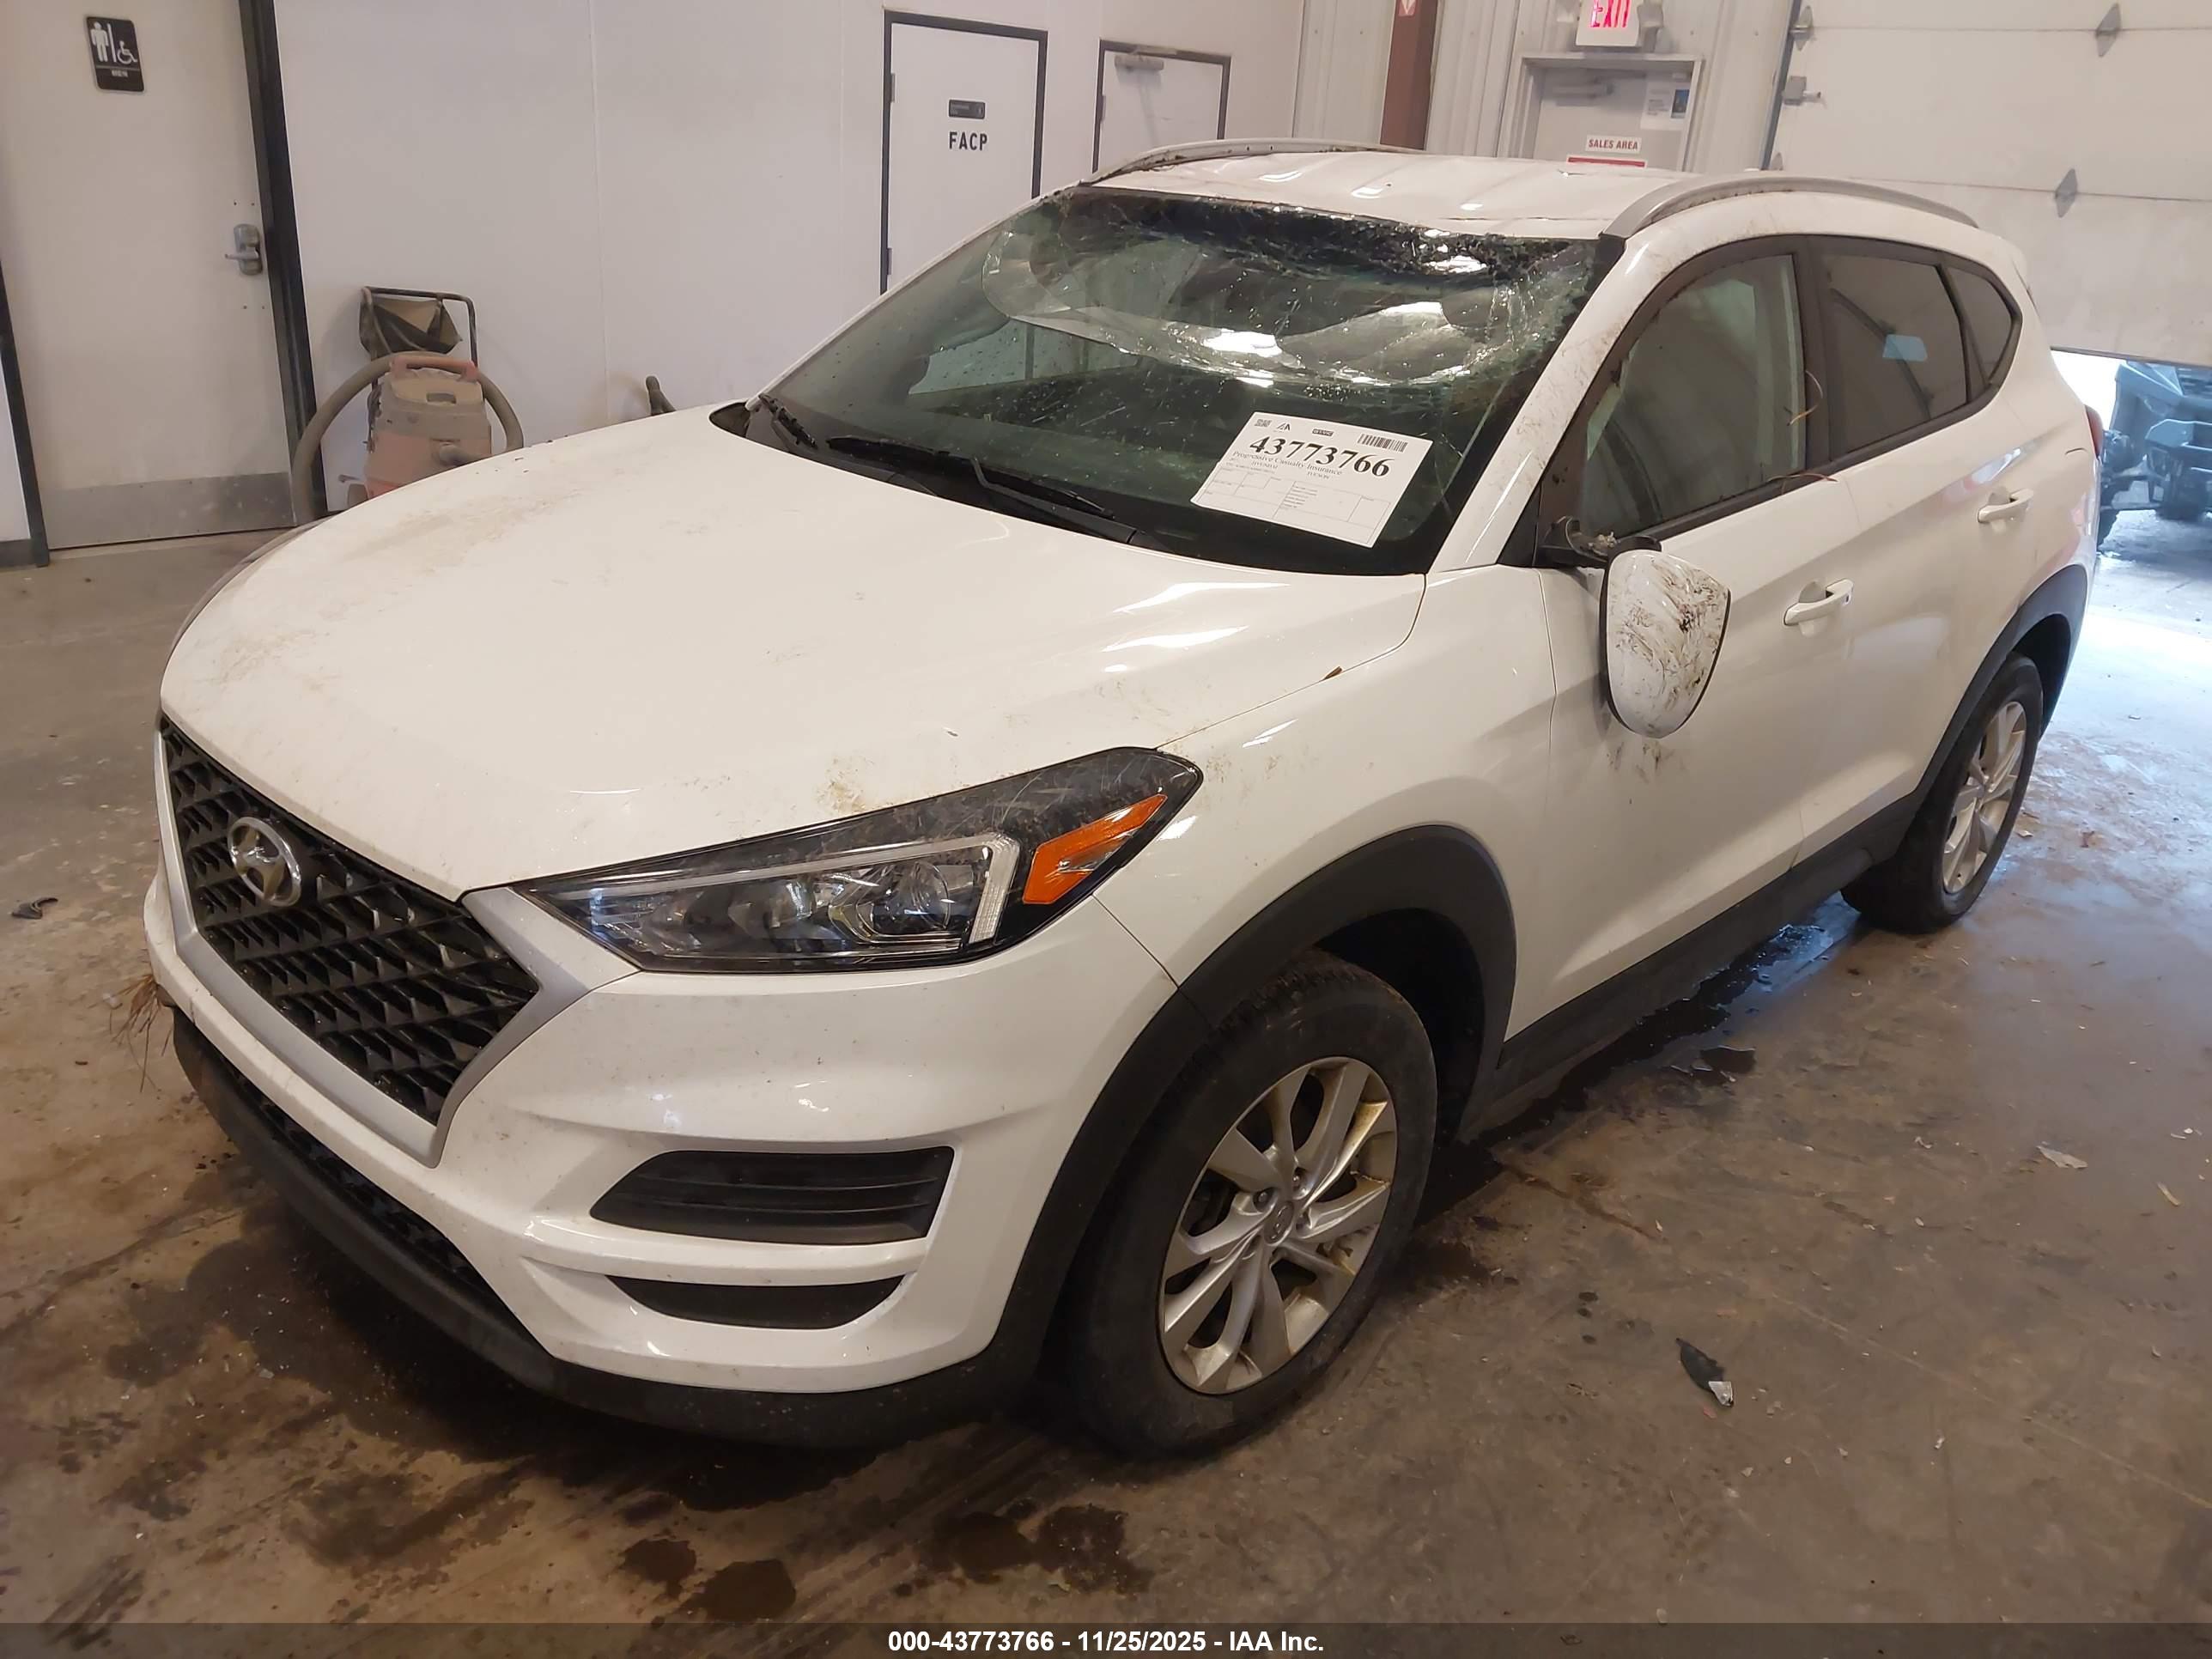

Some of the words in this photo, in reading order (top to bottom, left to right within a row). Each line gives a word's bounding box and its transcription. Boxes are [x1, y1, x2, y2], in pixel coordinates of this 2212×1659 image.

[949, 131, 988, 151] FACP
[1589, 139, 1613, 149] SALES
[1616, 140, 1638, 149] AREA
[1232, 451, 1273, 463] Progressive
[1275, 459, 1304, 469] Casualty
[1306, 464, 1342, 476] Insurance
[1249, 435, 1395, 477] 43773766
